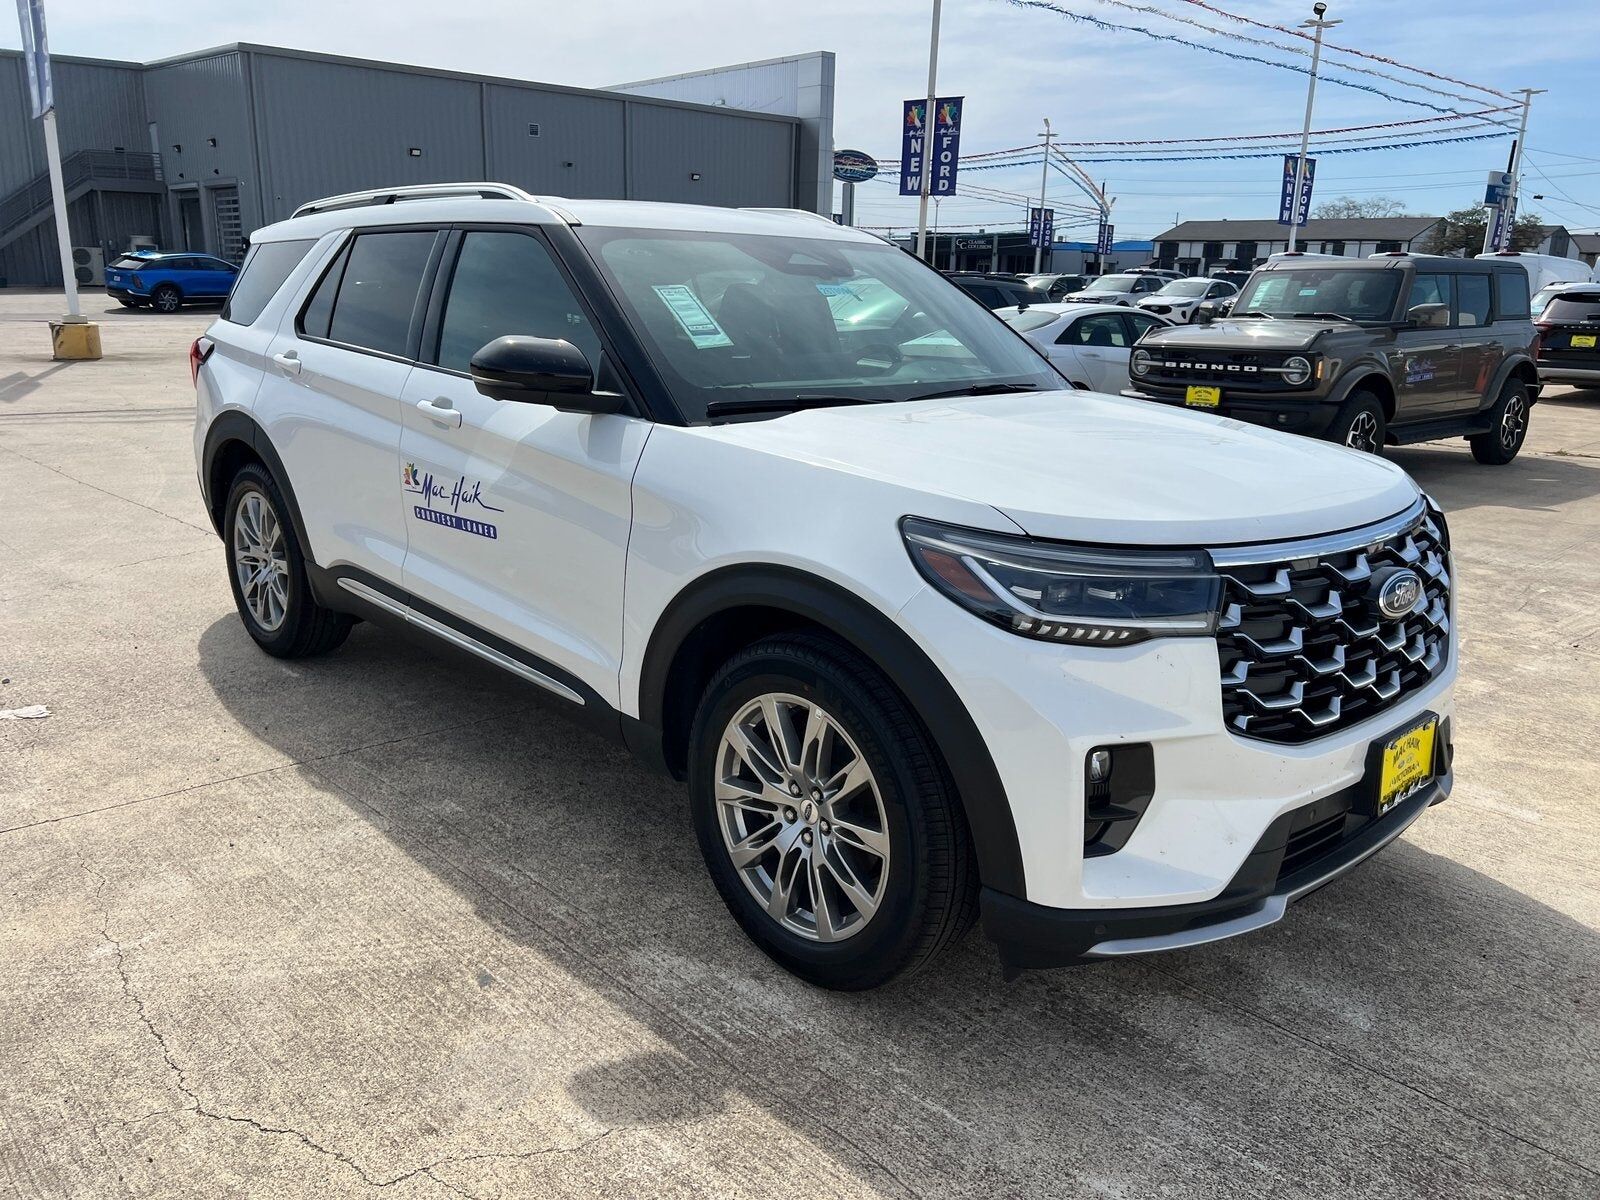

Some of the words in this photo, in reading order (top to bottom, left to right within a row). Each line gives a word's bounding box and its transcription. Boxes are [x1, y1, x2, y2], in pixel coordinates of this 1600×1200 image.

[907, 138, 921, 191] NEW
[938, 136, 953, 191] FORD
[1283, 183, 1293, 221] NEW
[1298, 185, 1309, 224] FORD
[1031, 223, 1039, 246] NEW
[1165, 361, 1258, 372] BRONCO
[412, 473, 450, 508] Mac
[451, 476, 501, 513] Haik
[416, 508, 457, 528] COURTESY
[1393, 580, 1416, 608] Ford
